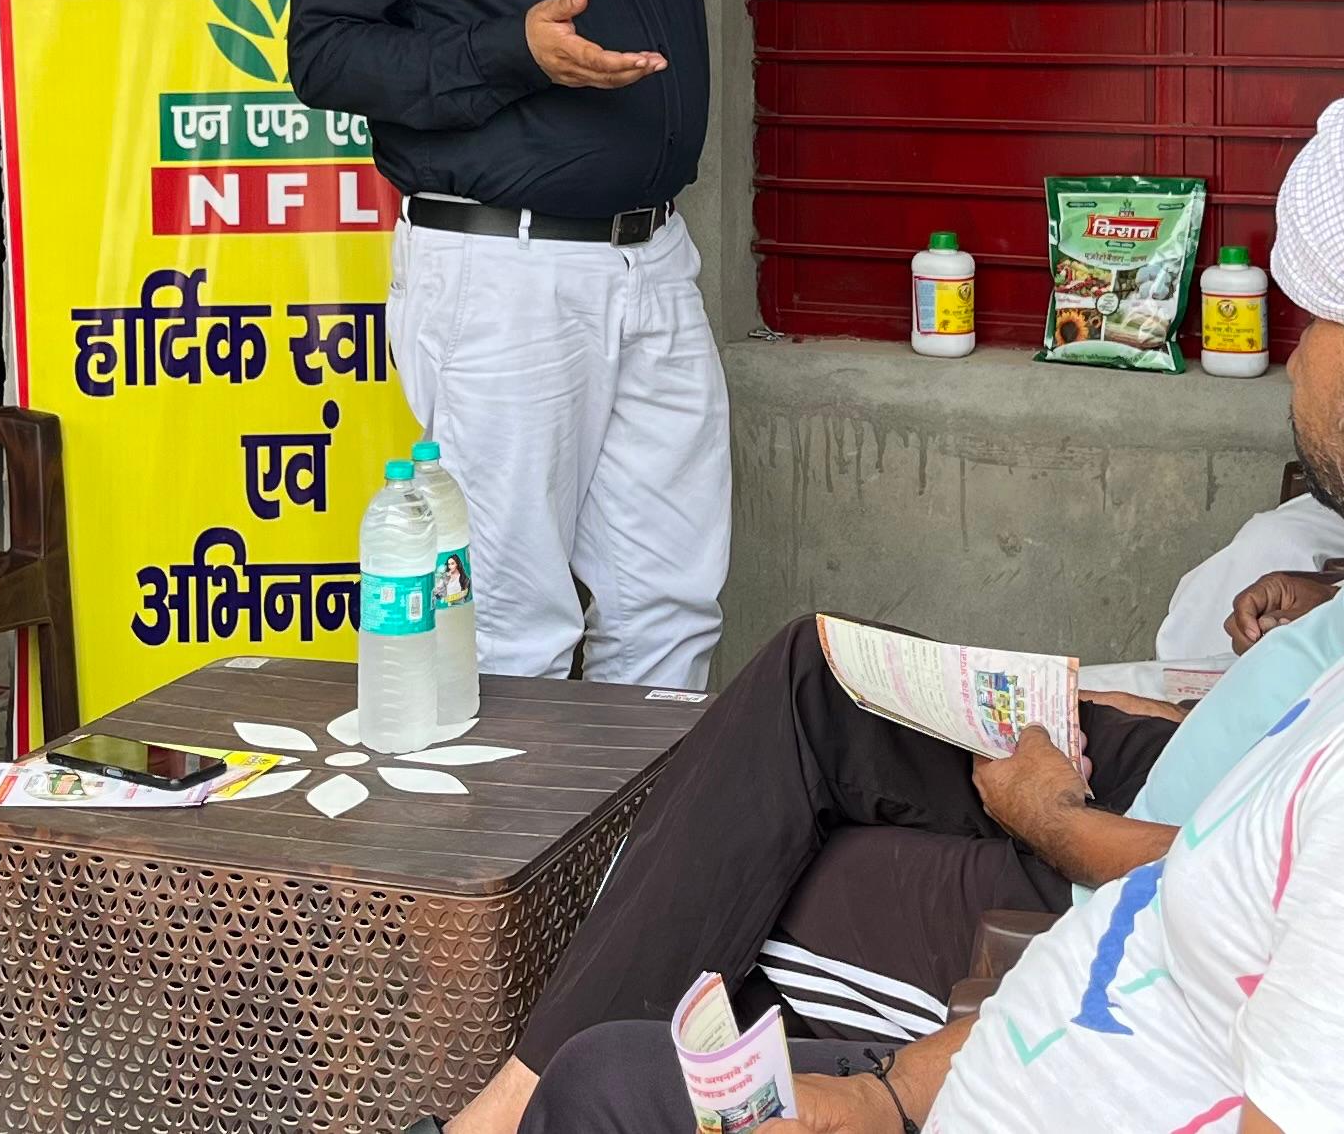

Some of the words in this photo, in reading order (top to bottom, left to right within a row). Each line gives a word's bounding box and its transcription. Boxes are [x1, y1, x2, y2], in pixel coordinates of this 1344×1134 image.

[171, 105, 232, 148] एन
[244, 104, 310, 147] एफ
[1092, 218, 1156, 240] किसान
[71, 268, 273, 397] हार्दिक
[287, 302, 398, 386] स्वा
[240, 400, 340, 520] एवं
[130, 527, 362, 647] अभिनन्
